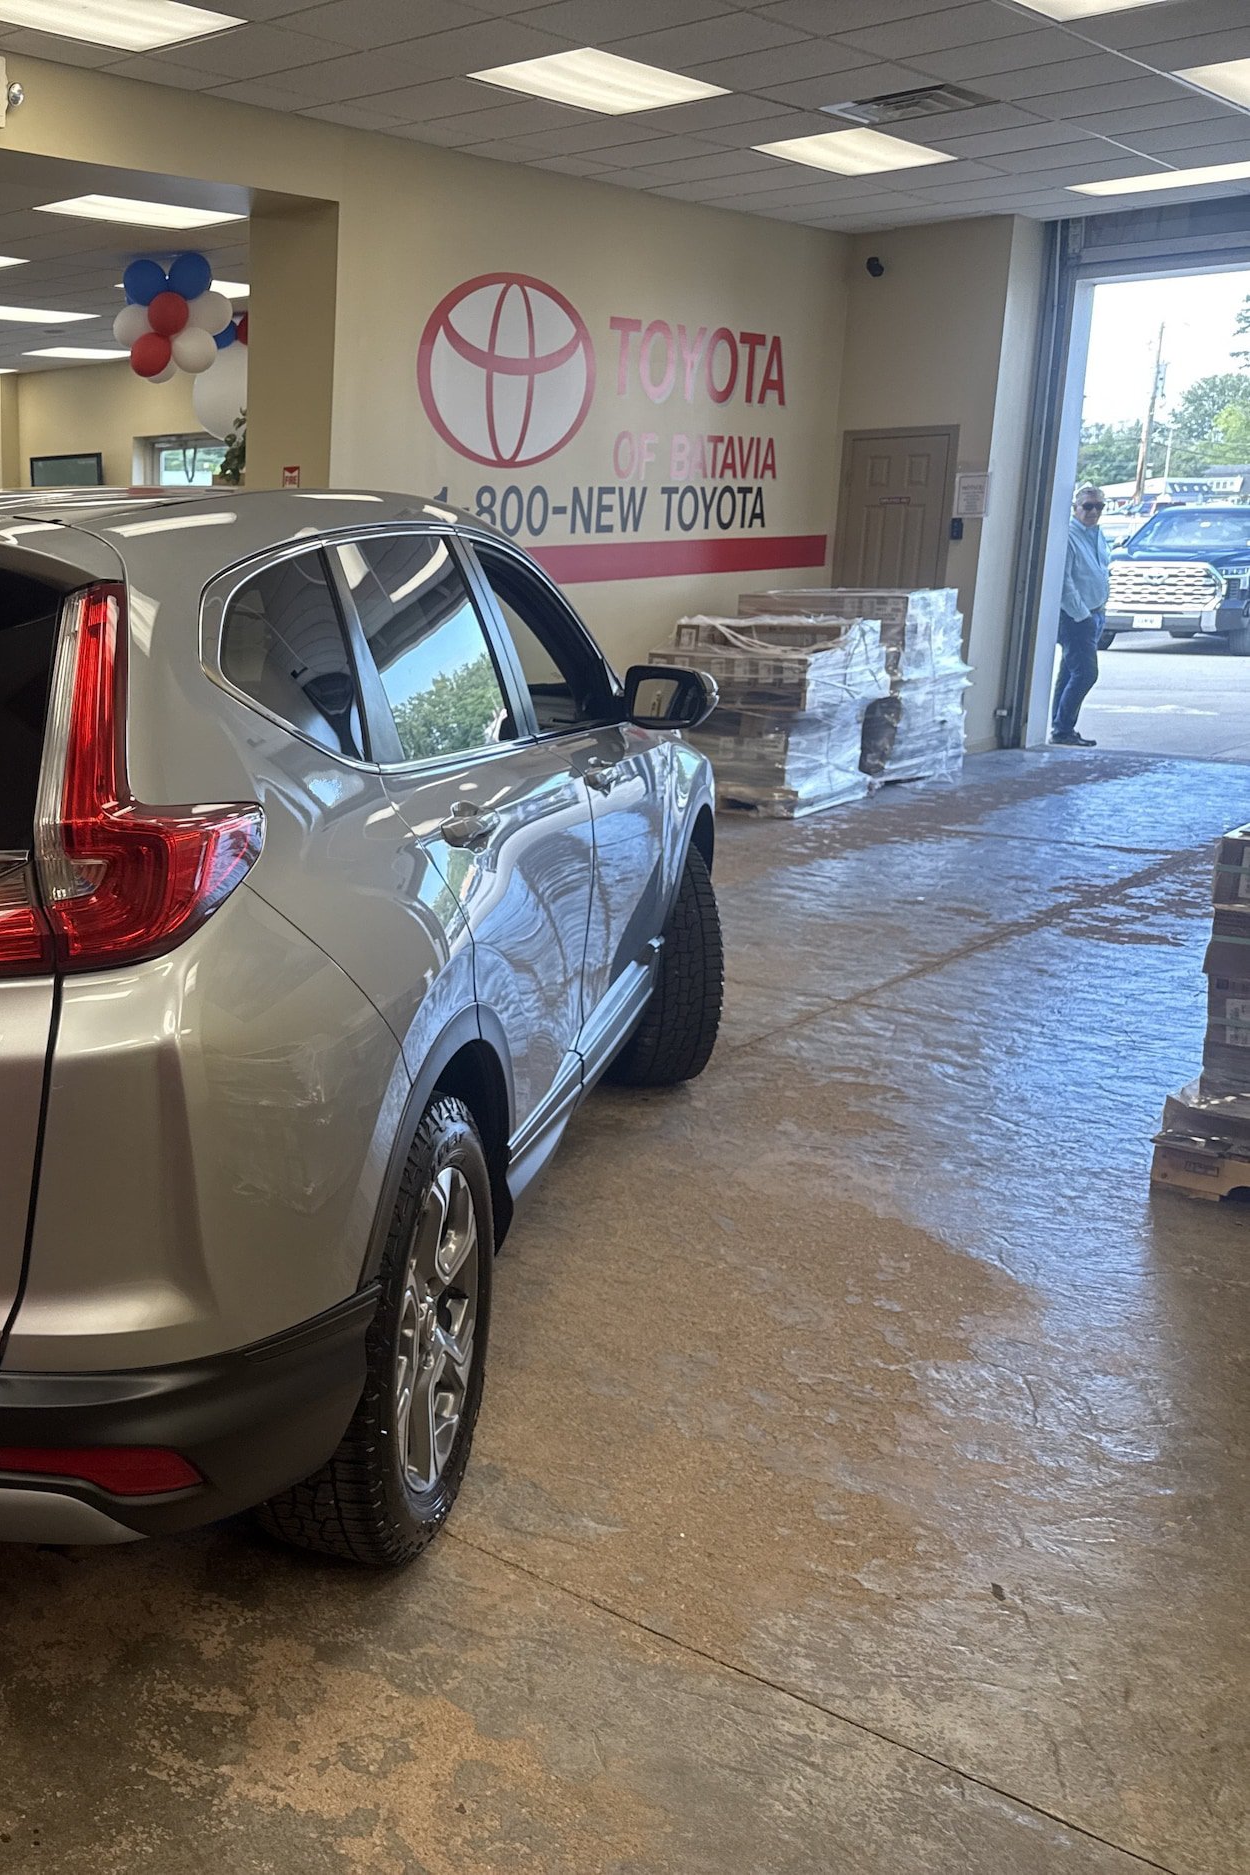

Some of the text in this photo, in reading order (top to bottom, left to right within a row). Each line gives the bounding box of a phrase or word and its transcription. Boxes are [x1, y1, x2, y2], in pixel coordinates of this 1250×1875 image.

[609, 316, 786, 407] TOYOTA
[612, 430, 777, 481] OF BATAVIA
[661, 485, 765, 532] TOYOTA
